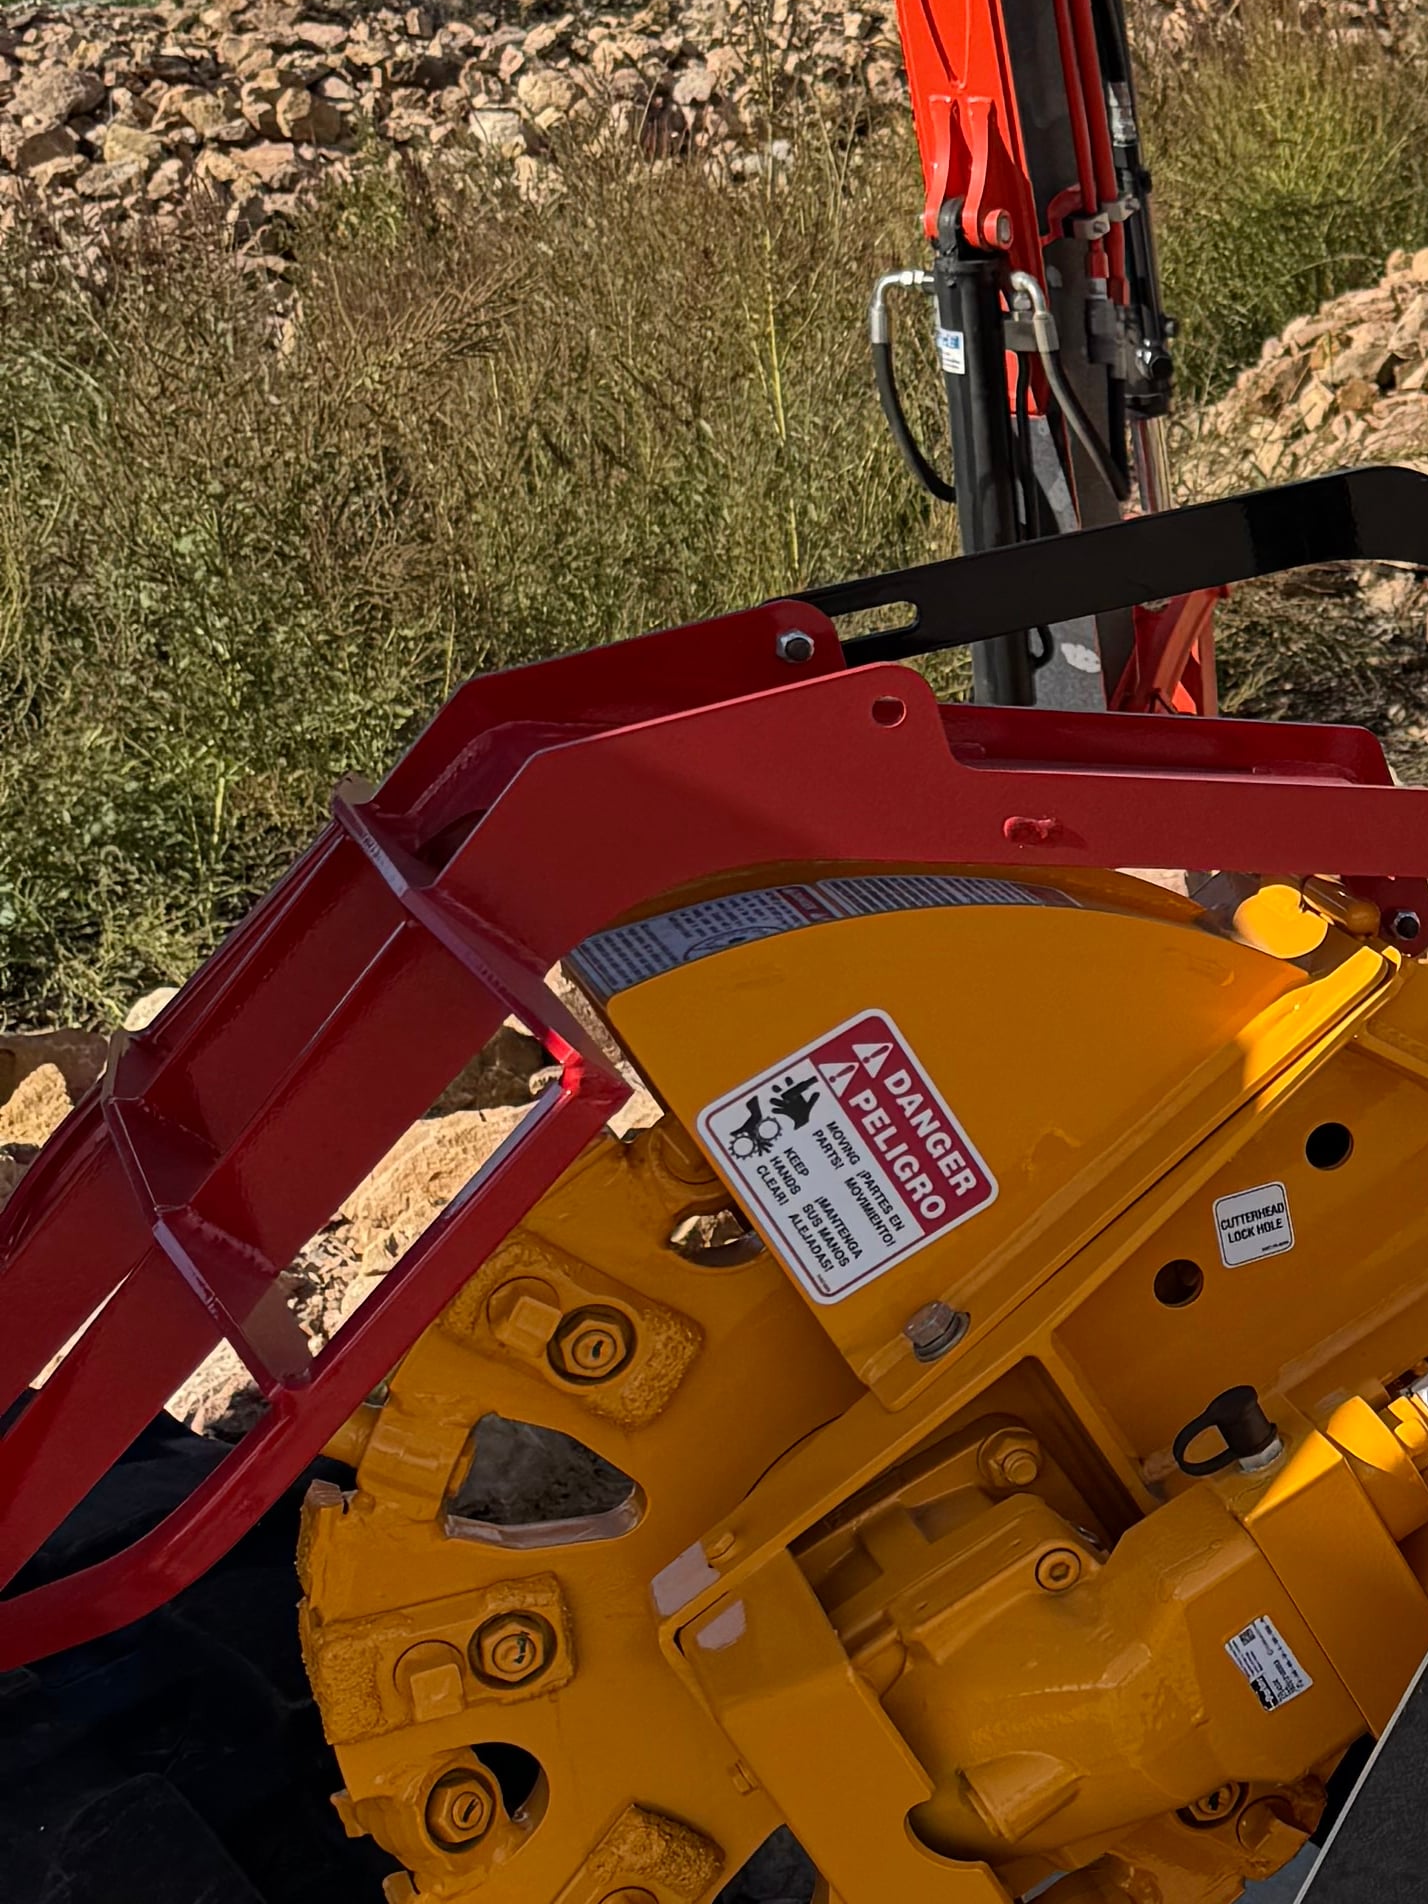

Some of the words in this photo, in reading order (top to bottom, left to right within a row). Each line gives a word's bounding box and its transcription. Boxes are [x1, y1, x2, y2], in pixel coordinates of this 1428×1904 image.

[812, 1130, 844, 1170] PARTS!
[826, 1121, 860, 1165] MOVING
[849, 1089, 946, 1220] PELIGRO
[884, 1069, 977, 1197] DANGER
[756, 1164, 789, 1206] CLEAR!
[769, 1156, 802, 1195] HANDS
[783, 1147, 810, 1177] KEEP
[844, 1178, 896, 1247] MOVIMIENTO!
[856, 1169, 894, 1216] ¡PARTES
[890, 1213, 905, 1232] EN
[1221, 1202, 1284, 1230] CUTTERHEAD
[788, 1213, 834, 1273] ALEJADAS!
[802, 1204, 822, 1228] SUS
[819, 1226, 850, 1268] MANOS
[814, 1196, 863, 1260] ¡MANTENGA
[1228, 1226, 1255, 1243] LOCK
[1256, 1218, 1283, 1235] HOLE
